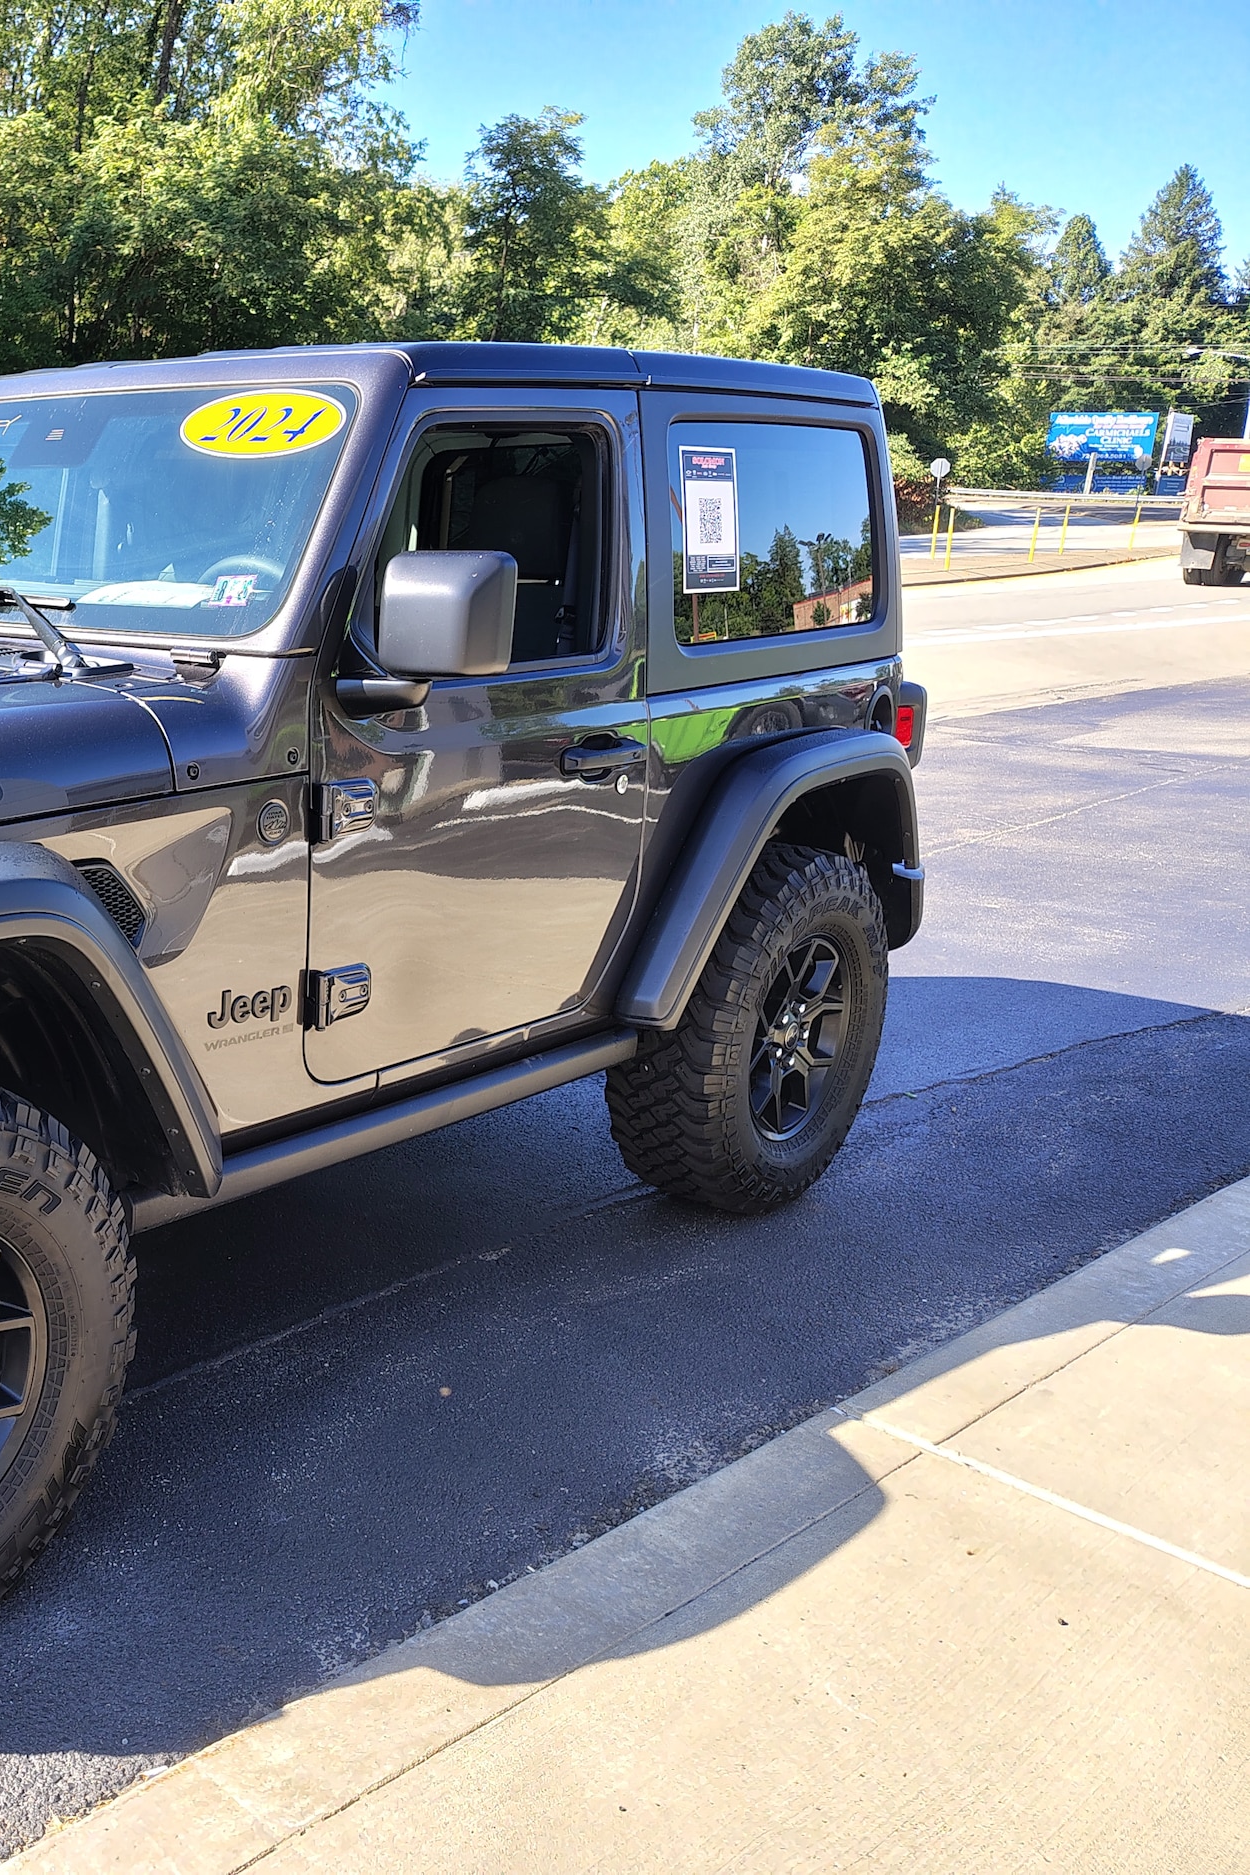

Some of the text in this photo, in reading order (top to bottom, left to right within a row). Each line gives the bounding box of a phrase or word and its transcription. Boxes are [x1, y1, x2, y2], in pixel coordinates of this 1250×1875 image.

[198, 406, 328, 442] 2024
[1100, 436, 1133, 444] CLINIC
[206, 985, 293, 1030] Jeep
[202, 1026, 280, 1052] WRANGLER
